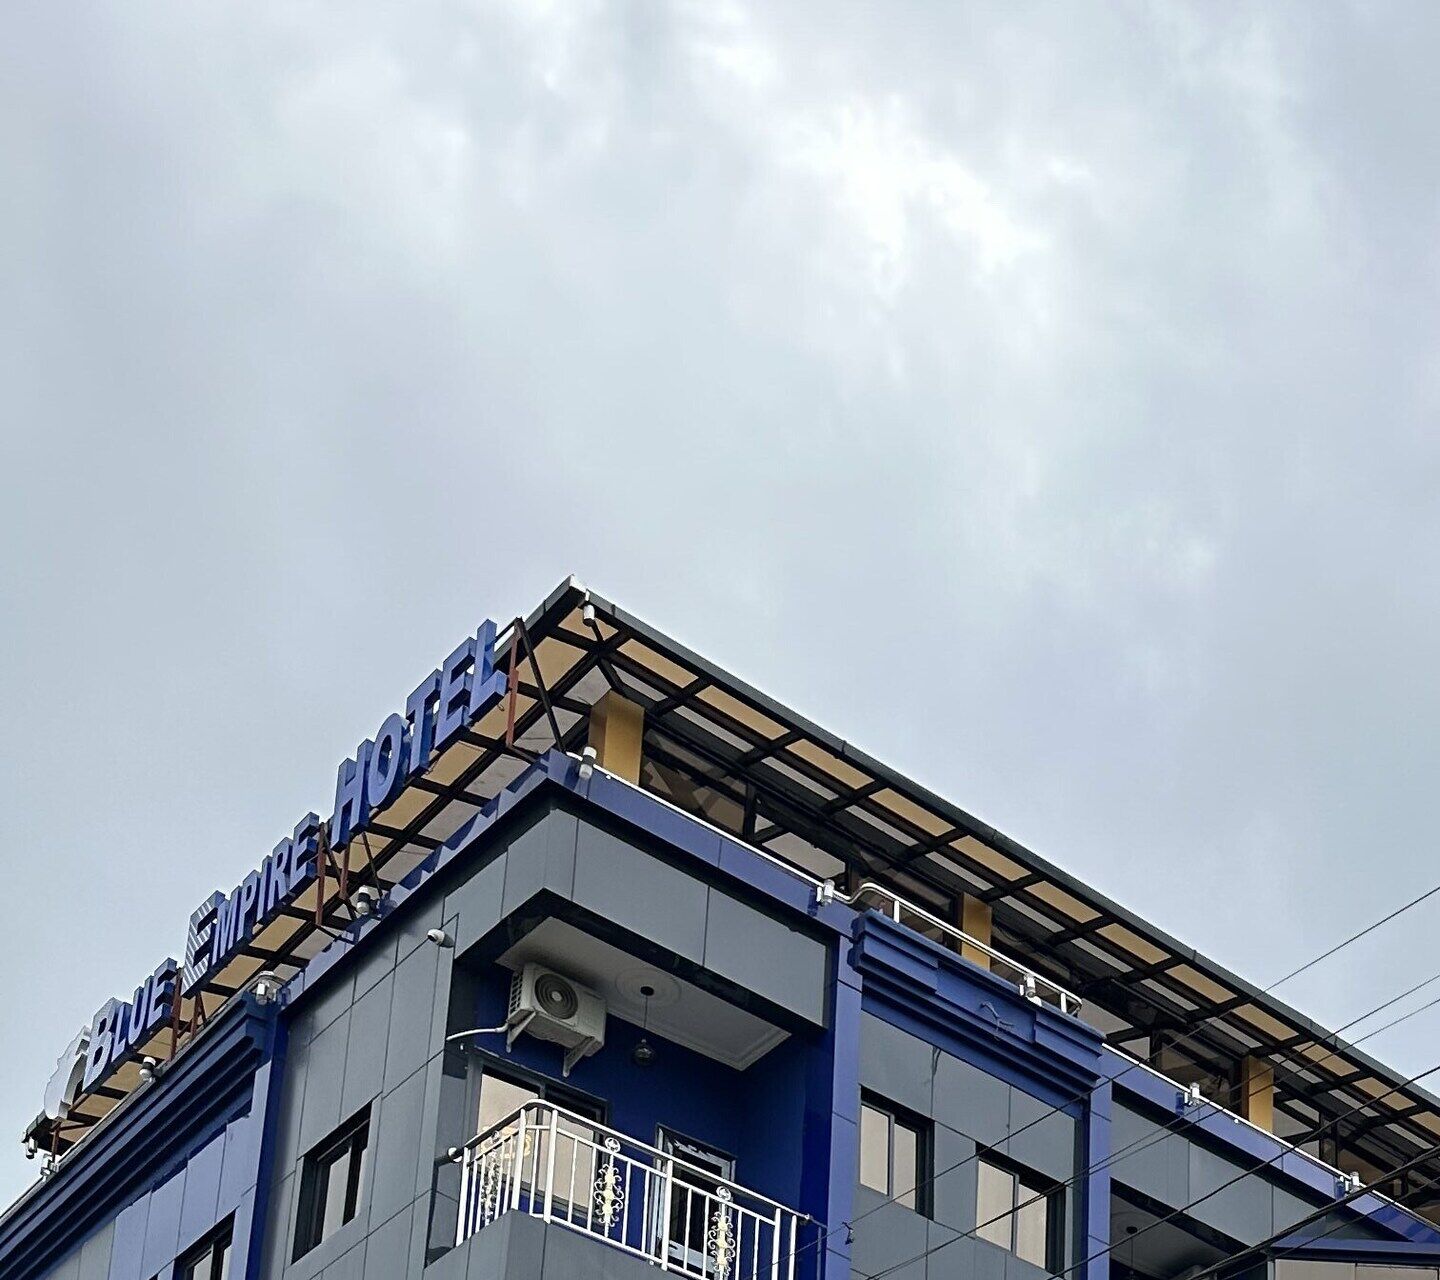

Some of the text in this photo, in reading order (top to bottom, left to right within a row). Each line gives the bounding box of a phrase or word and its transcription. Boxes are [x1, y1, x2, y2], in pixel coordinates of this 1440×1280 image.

[83, 619, 509, 1094] BLUE EMPIRE HOTEL
